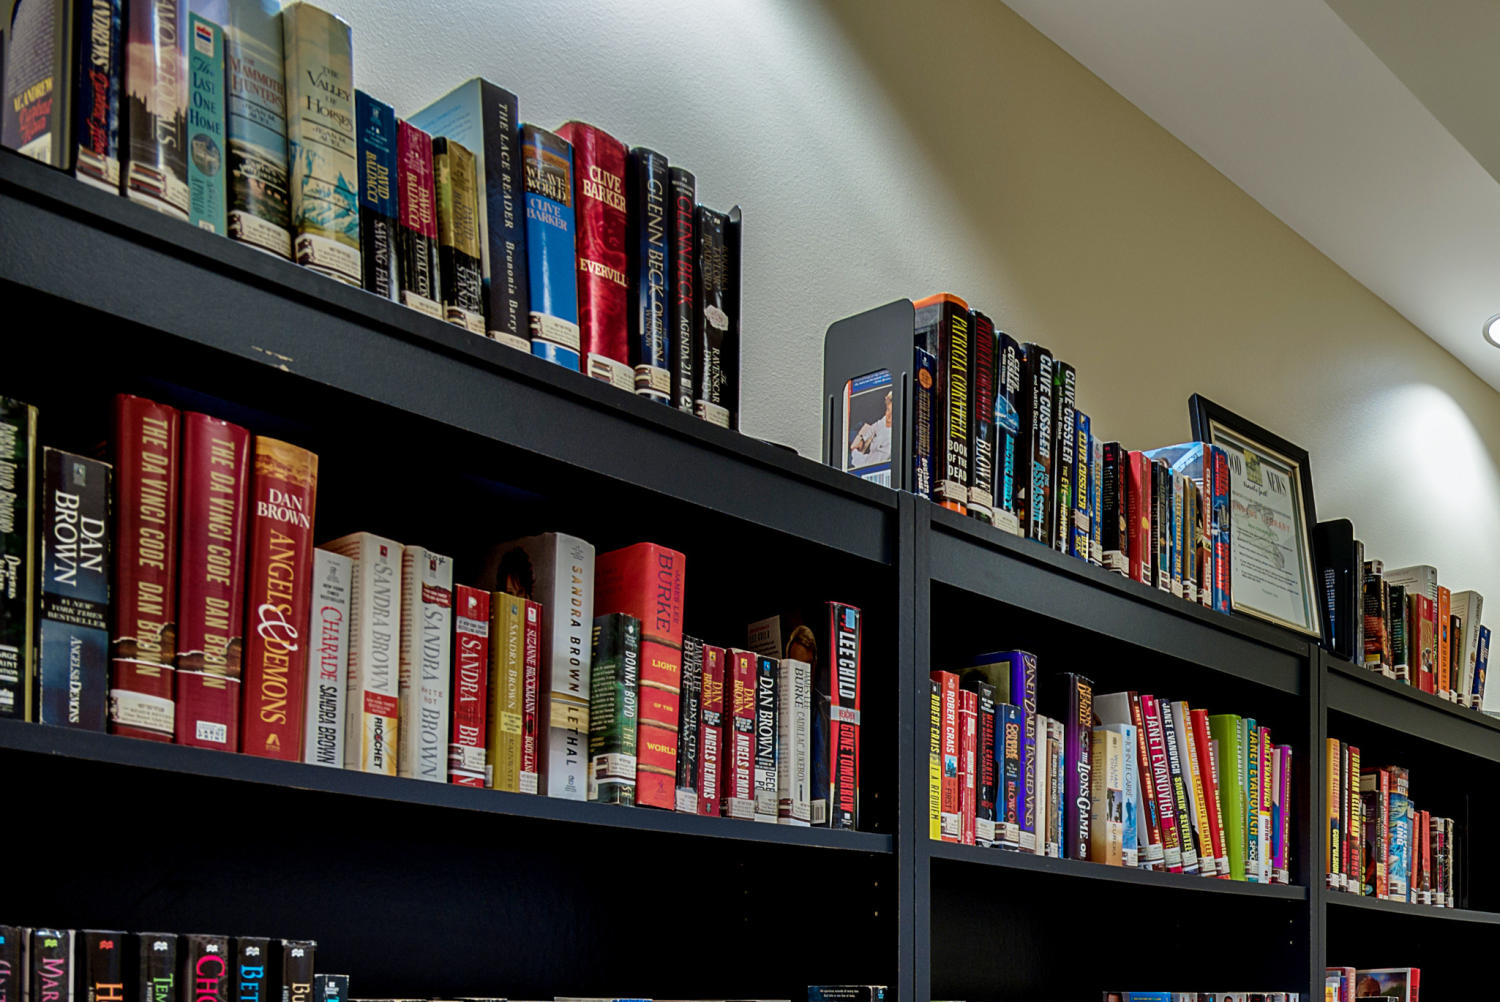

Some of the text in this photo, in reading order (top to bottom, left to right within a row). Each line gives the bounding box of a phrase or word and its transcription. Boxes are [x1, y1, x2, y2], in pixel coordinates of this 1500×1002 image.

[193, 72, 215, 93] LAST
[193, 90, 216, 114] ONE
[306, 95, 353, 130] HORSES
[307, 70, 352, 101] VALLEY
[190, 110, 221, 136] HOME
[366, 151, 389, 204] DAVID BALDACCI
[498, 104, 514, 229] THE LACE READER
[583, 179, 626, 213] BARKER
[589, 165, 621, 193] CLIVE
[526, 208, 568, 232] BARKER
[676, 196, 694, 309] GLENN BECK
[951, 314, 967, 441] PATRICIA CORNWELL
[1006, 346, 1015, 394] CUSSLER
[1012, 358, 1020, 392] CLIVE
[1039, 354, 1051, 458] CLIVE CUSSLER
[1063, 369, 1076, 464] CLIVE CUSSLER
[948, 440, 967, 455] BOOK
[949, 454, 967, 469] OF THE
[949, 465, 967, 481] DEAD
[1078, 431, 1087, 509] CLIVE CUSSLER
[138, 416, 167, 571] THE DA VINCI CODE
[207, 438, 234, 586] THE DA VINCI CODE
[269, 488, 303, 510] DAN
[1032, 460, 1045, 524] ASSASSIN
[1266, 470, 1287, 496] NEWS
[54, 489, 80, 587] BROWN
[80, 515, 105, 574] DAN
[257, 501, 310, 529] BROWN
[656, 552, 673, 632] BURKE
[316, 606, 342, 681] CHARADE
[370, 563, 393, 692] SANDRA BROWN
[423, 607, 443, 688] SANDRA
[570, 564, 583, 692] SANDRA BROWN
[460, 636, 482, 702] SANDRA
[651, 660, 678, 673] LIGHT
[839, 631, 856, 700] LEE CHILD
[418, 708, 441, 778] BROWN
[565, 707, 578, 766] LETHAL
[647, 741, 676, 756] WORLD
[759, 677, 773, 761] DAN BROWN
[930, 694, 940, 756] ROBERT CRAIS
[946, 691, 955, 753] ROBERT CRAIS
[1162, 703, 1181, 774] JANET EVANOVICH
[1146, 715, 1173, 819] JANET EVANOVICH
[1249, 730, 1259, 835] JANET EVANOVICH
[1263, 760, 1271, 808] EVANOVICH
[1352, 753, 1360, 837] JONATHAN KELLERMAN
